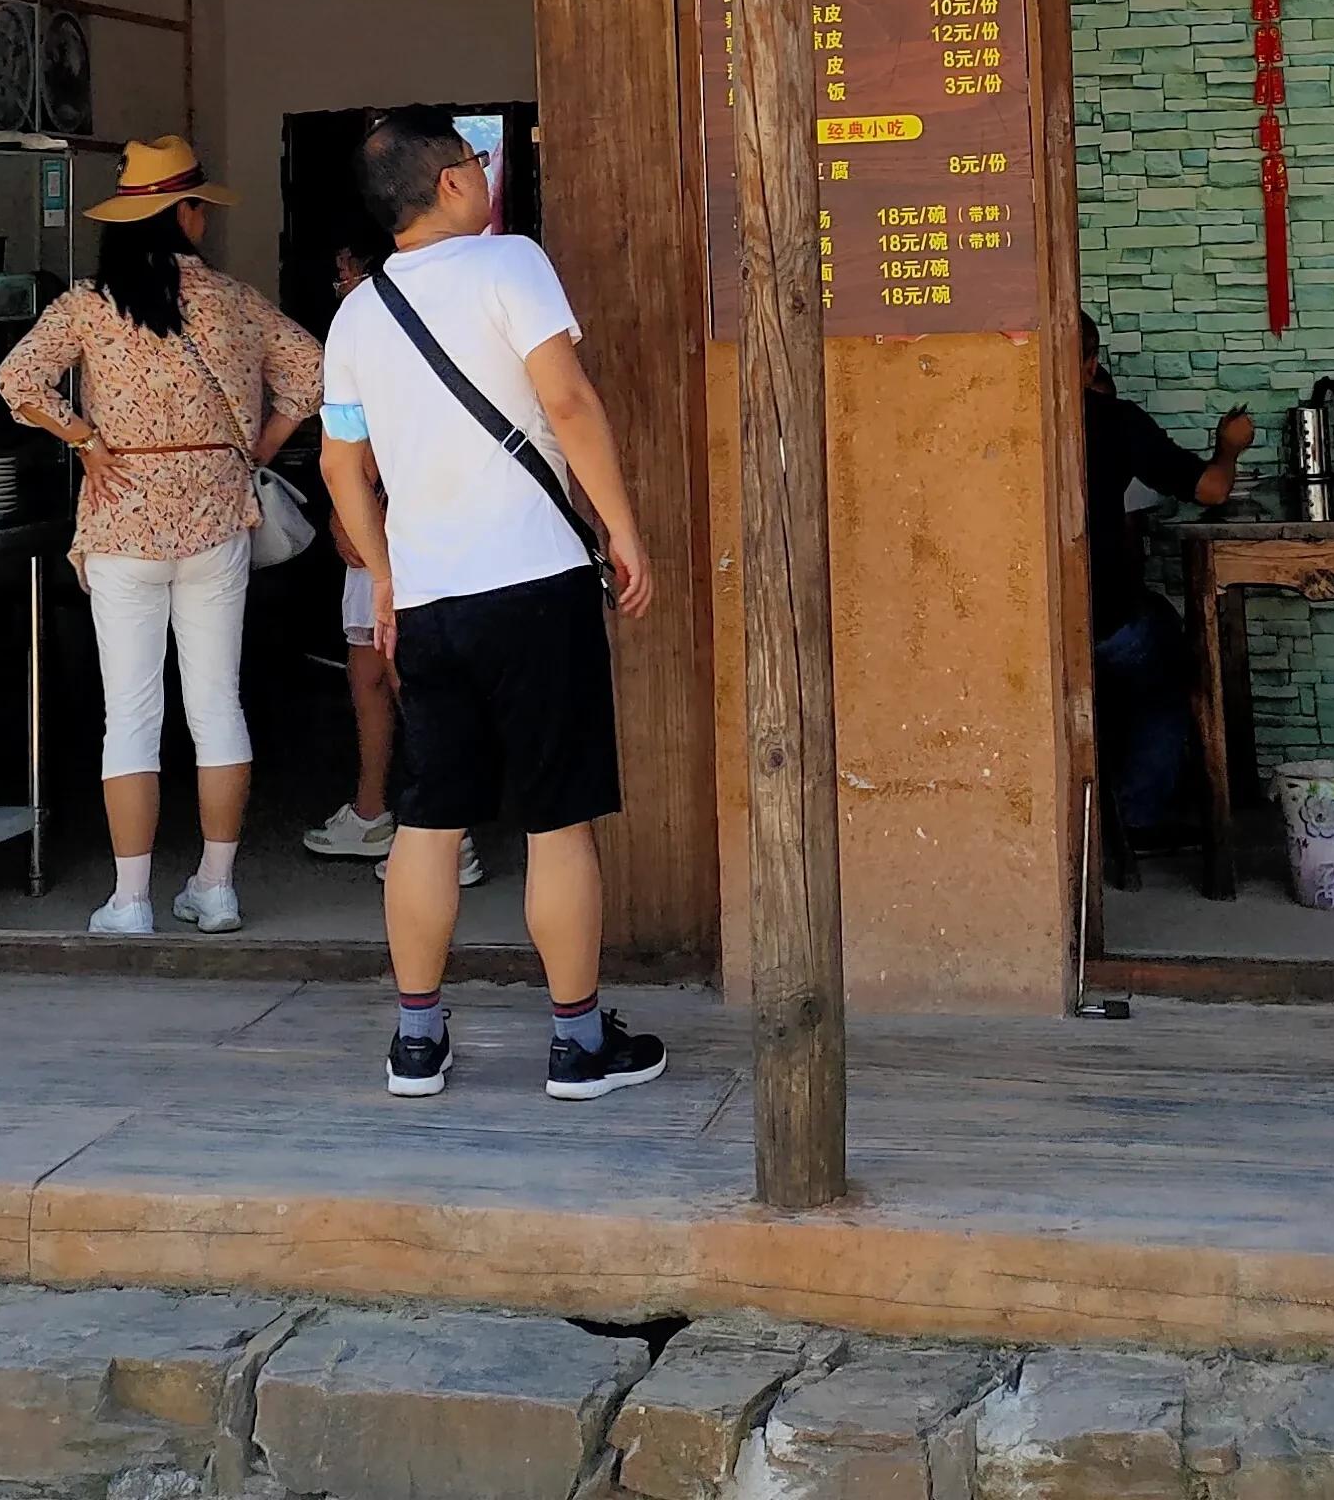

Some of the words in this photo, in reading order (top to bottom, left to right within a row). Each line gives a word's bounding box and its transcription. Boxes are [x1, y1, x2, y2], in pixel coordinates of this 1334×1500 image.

[932, 21, 1000, 43] 12元/份
[827, 56, 845, 76] 皮
[943, 48, 1001, 69] 8元/份
[827, 82, 846, 102] 饭
[945, 73, 1003, 95] 3元/份
[827, 118, 906, 141] 经典小吃
[949, 153, 1007, 174] 8元/份
[877, 206, 947, 227] 18元/碗
[878, 231, 948, 253] 18元/碗
[879, 259, 950, 280] 18元/碗
[881, 285, 952, 306] 18元/碗
